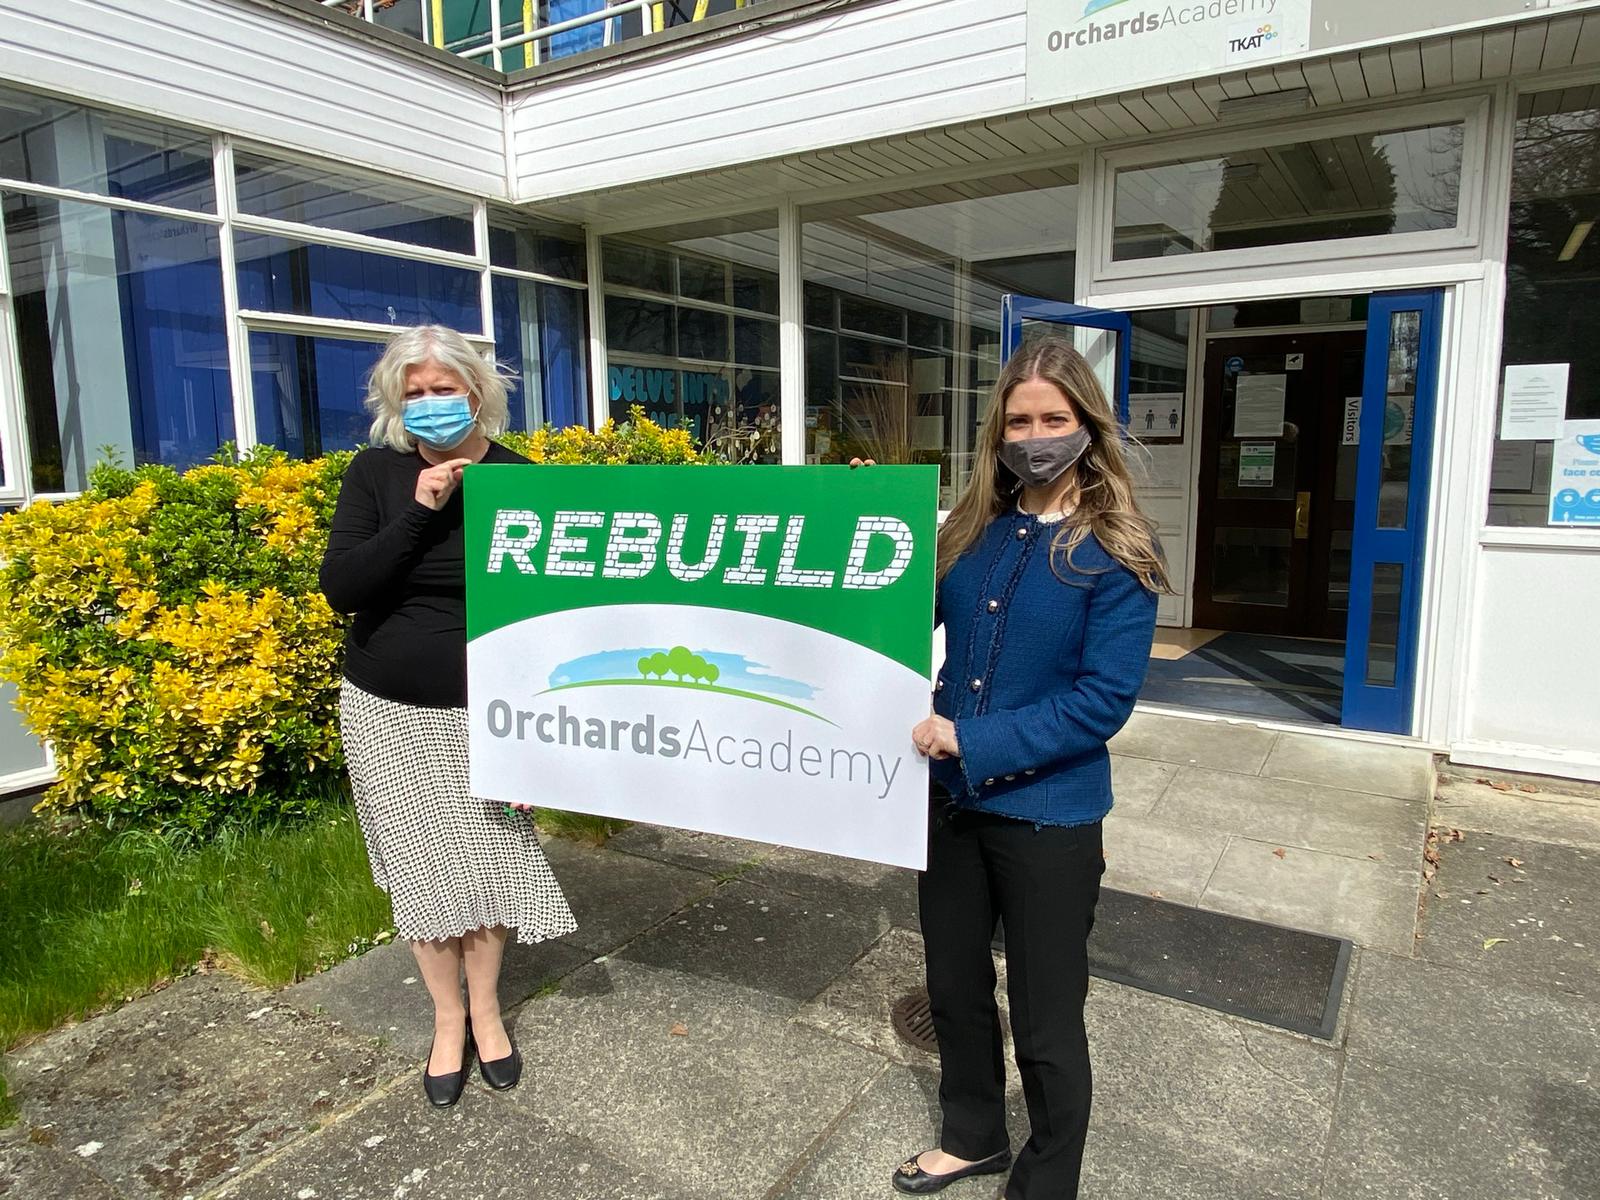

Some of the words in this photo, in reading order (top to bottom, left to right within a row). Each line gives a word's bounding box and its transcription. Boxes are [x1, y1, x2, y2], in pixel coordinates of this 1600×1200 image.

[1229, 34, 1264, 53] TKAT
[608, 366, 675, 404] DELVE
[1345, 400, 1359, 442] Visitors
[487, 509, 914, 591] REBUILD
[487, 699, 902, 799] OrchardsAcademy
